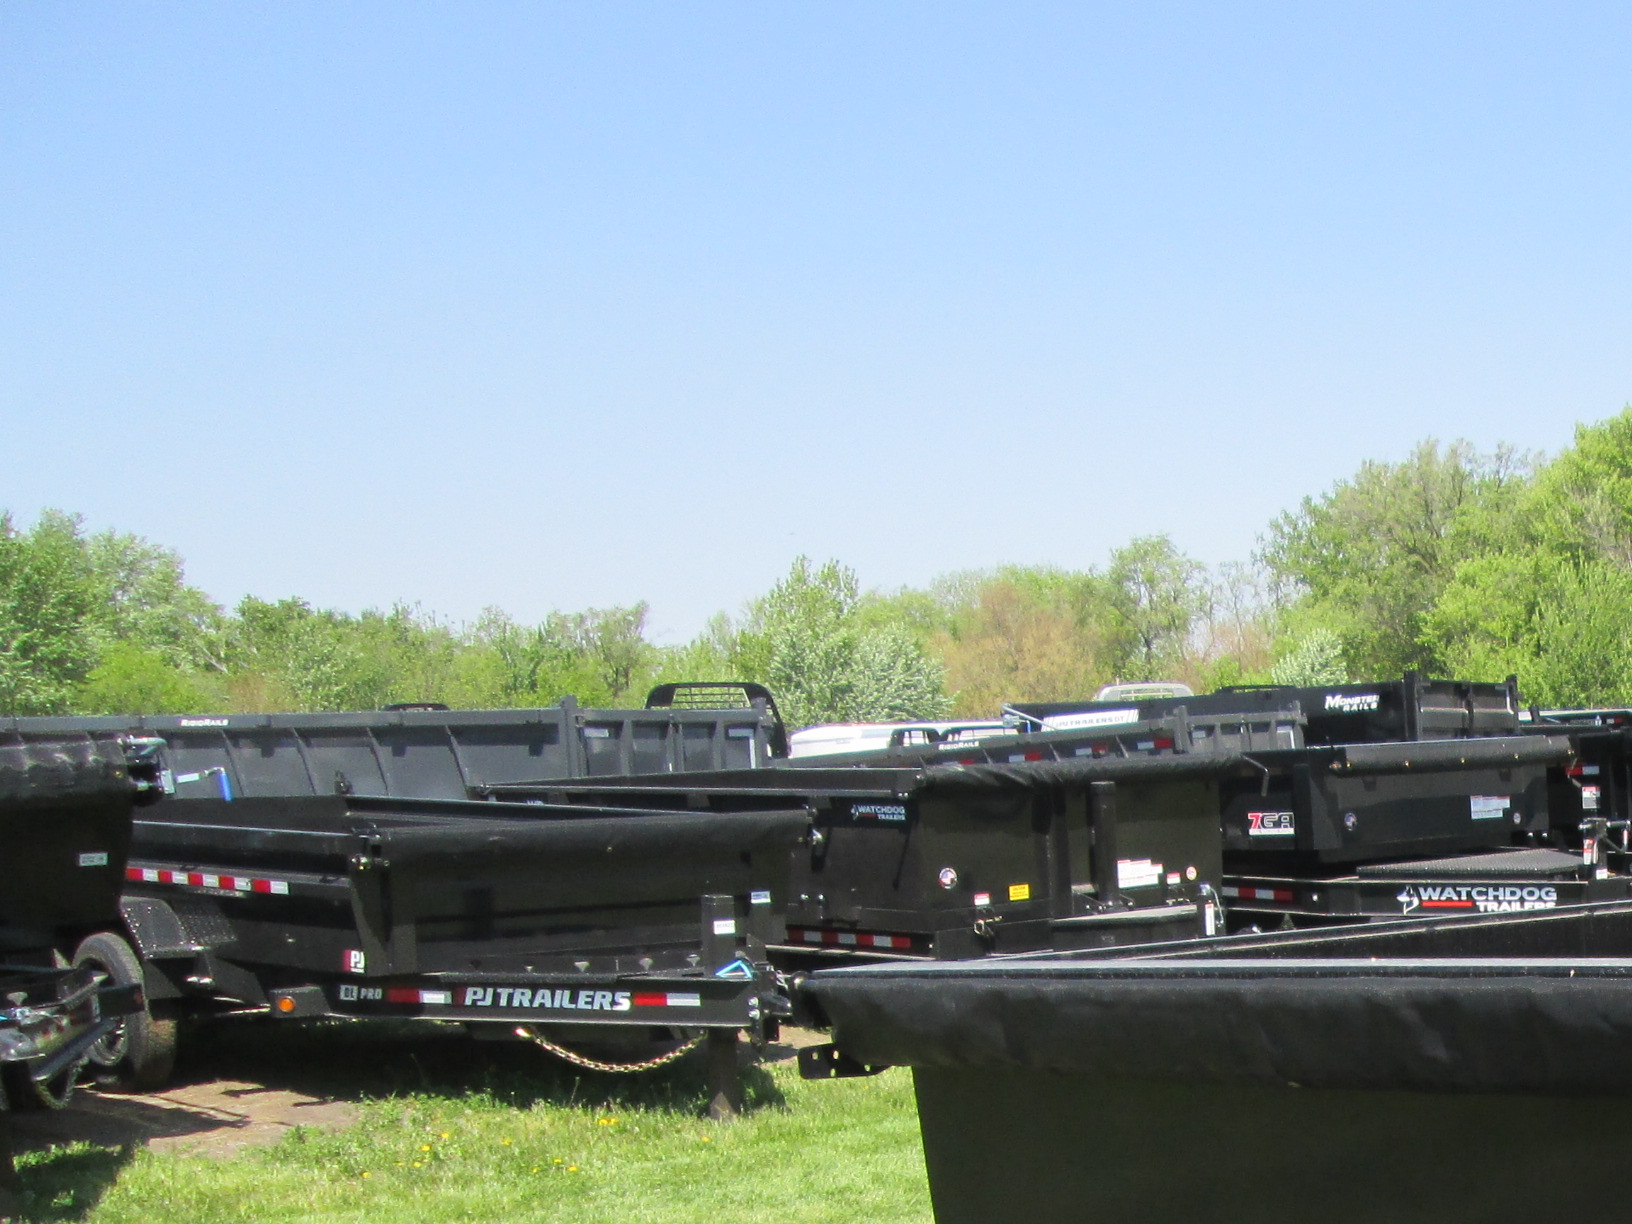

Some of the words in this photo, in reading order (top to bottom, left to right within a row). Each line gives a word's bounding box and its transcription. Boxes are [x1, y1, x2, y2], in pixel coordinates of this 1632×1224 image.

[1343, 704, 1378, 712] RAILS
[858, 805, 906, 814] WATCHDOG
[1418, 886, 1558, 901] WATCHDOG
[360, 988, 383, 1000] PRO
[465, 986, 494, 1006] PJ
[496, 987, 632, 1012] TRAILERS
